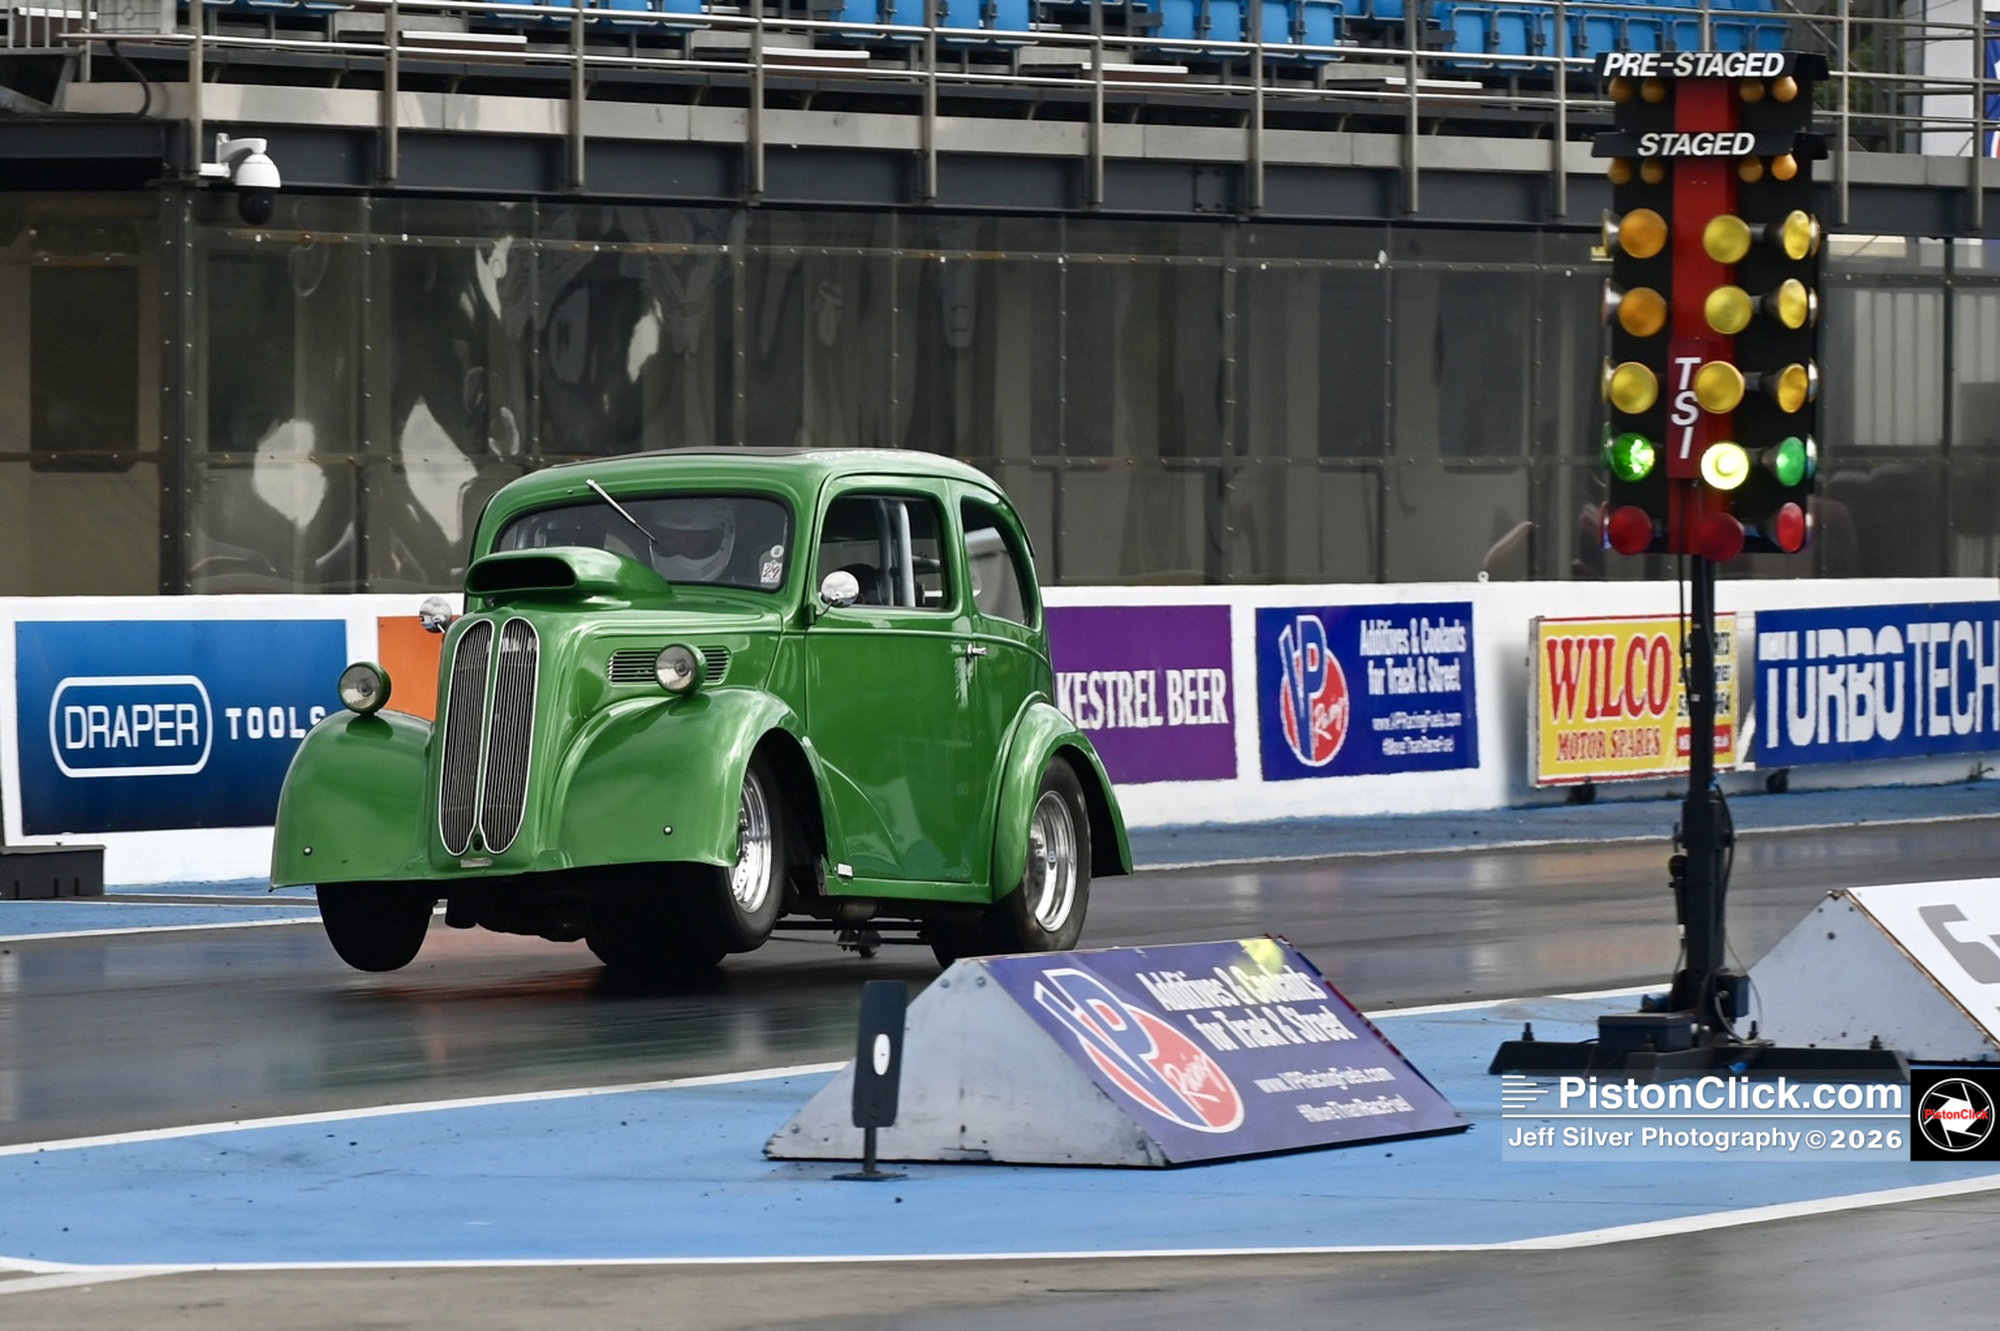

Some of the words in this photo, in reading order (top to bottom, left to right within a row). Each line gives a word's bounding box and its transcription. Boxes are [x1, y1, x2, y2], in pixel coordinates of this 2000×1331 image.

[1602, 52, 1785, 77] PRE-STAGED
[1637, 132, 1755, 156] STAGED
[1546, 634, 1673, 722] WILCO
[1056, 670, 1163, 730] KESTREL
[1166, 668, 1229, 726] BEER
[64, 703, 199, 749] DRAPER
[1556, 729, 1606, 762] MOTOR
[1610, 727, 1662, 760] SPARES
